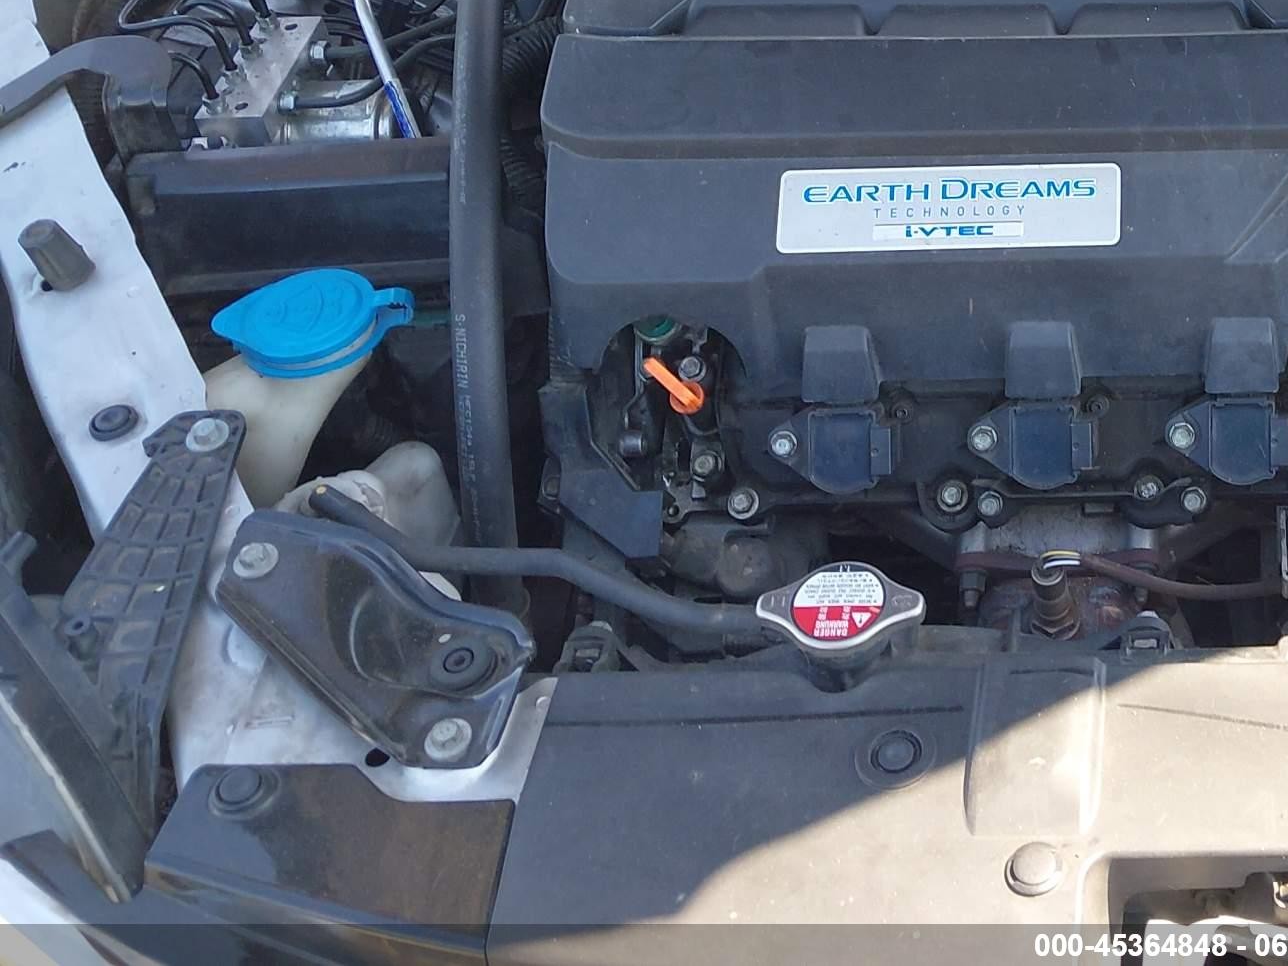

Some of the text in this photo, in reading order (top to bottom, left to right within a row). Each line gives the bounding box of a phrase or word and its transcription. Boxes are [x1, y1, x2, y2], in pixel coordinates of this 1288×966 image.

[803, 178, 1096, 203] EARTH DREAMS
[873, 204, 1026, 219] TECHNOLOGY
[905, 224, 994, 238] i-VTEC
[814, 627, 848, 637] DANGER
